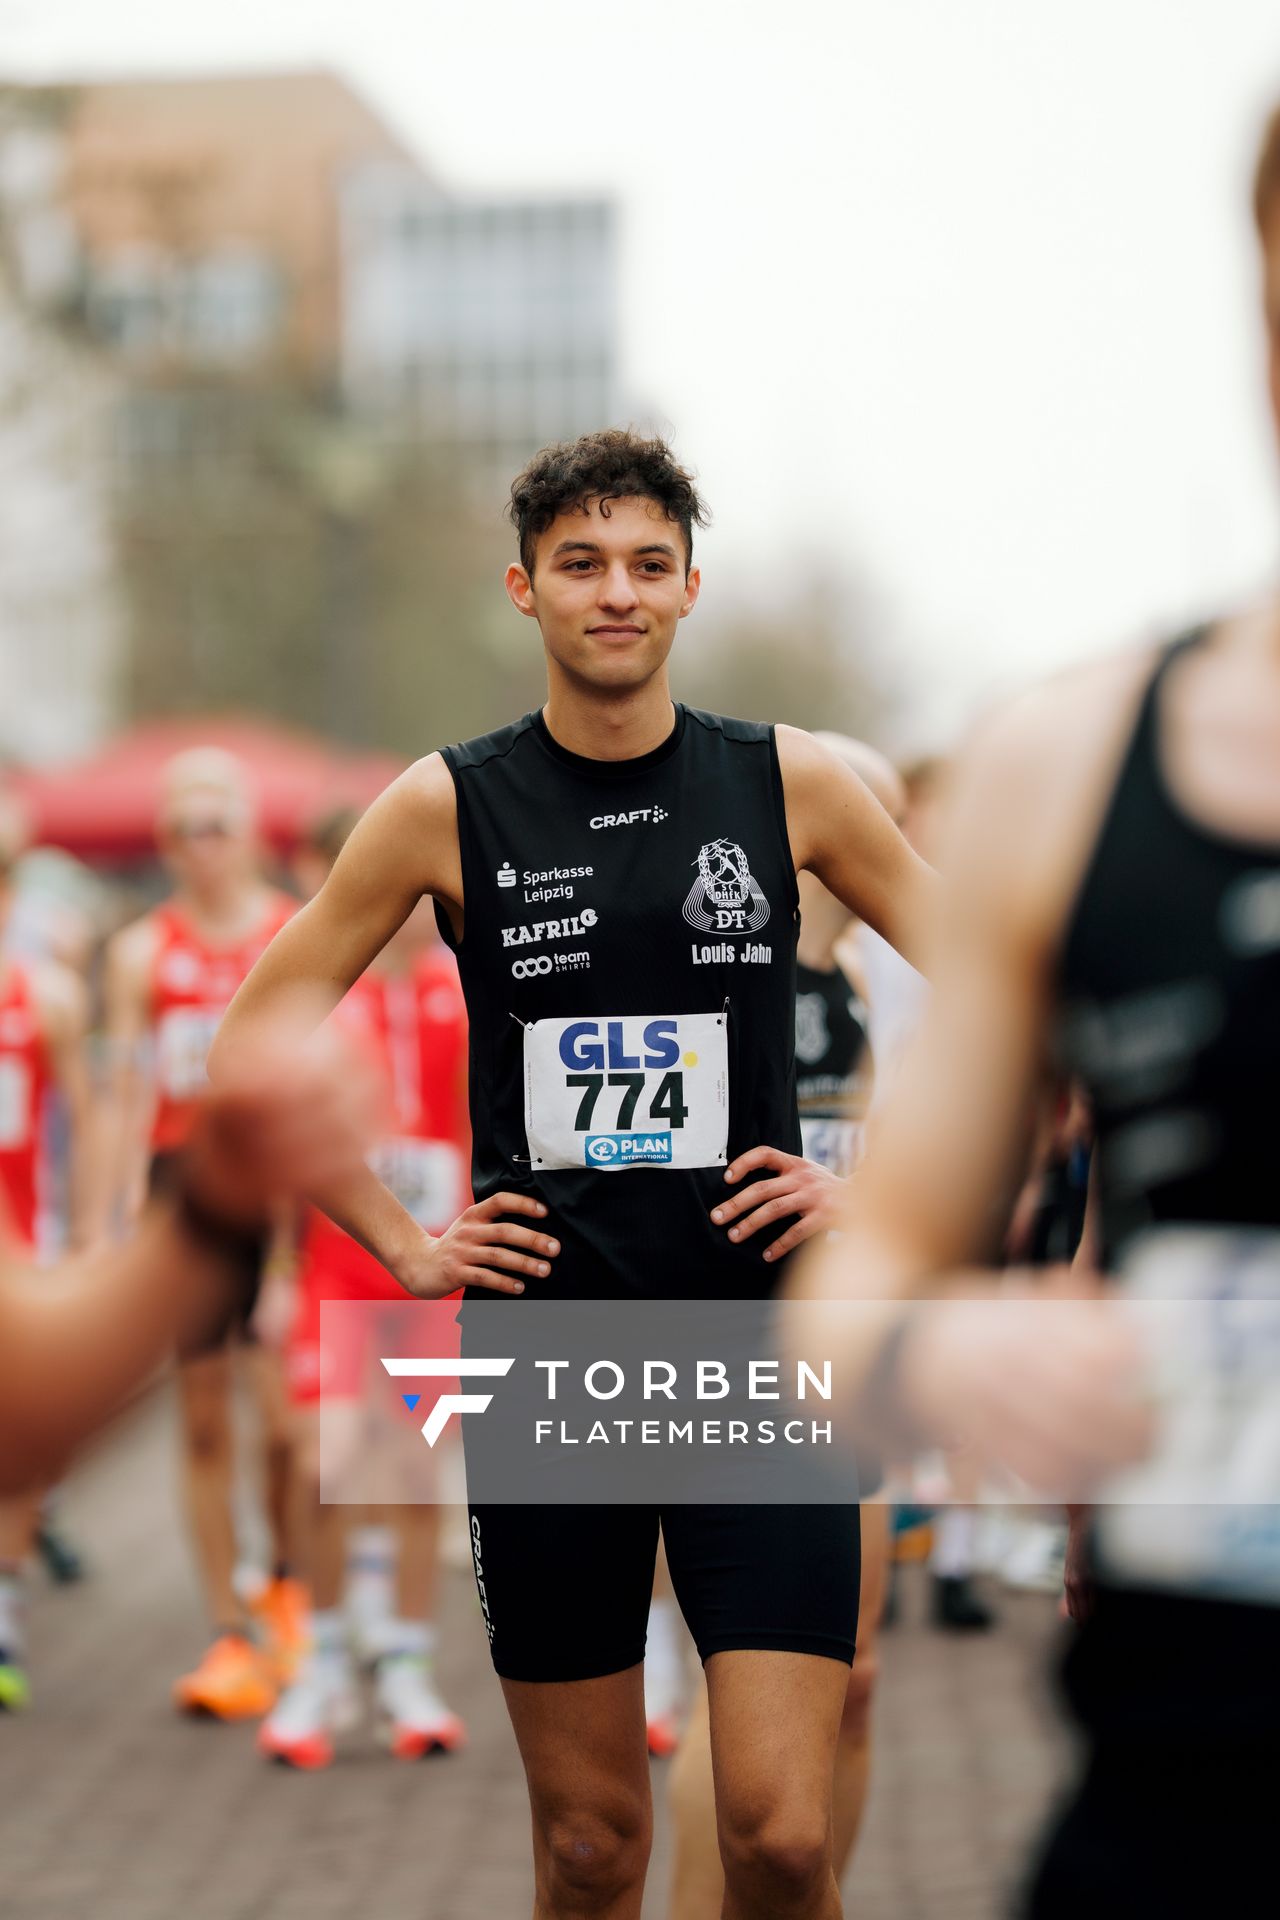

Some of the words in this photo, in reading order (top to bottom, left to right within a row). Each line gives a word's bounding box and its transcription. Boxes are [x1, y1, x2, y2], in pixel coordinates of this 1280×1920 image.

[590, 809, 652, 829] CRAFT
[523, 864, 594, 886] Sparkasse
[524, 884, 574, 903] Leipzig
[715, 910, 746, 929] DT
[554, 951, 590, 965] team
[692, 942, 735, 965] Louis
[741, 943, 772, 965] Jahn
[555, 962, 591, 973] SHIRTS
[566, 1071, 689, 1132] 774
[621, 1138, 669, 1153] PLAN
[621, 1153, 669, 1161] INTERNATIONAL
[471, 1515, 490, 1619] CRAFT
